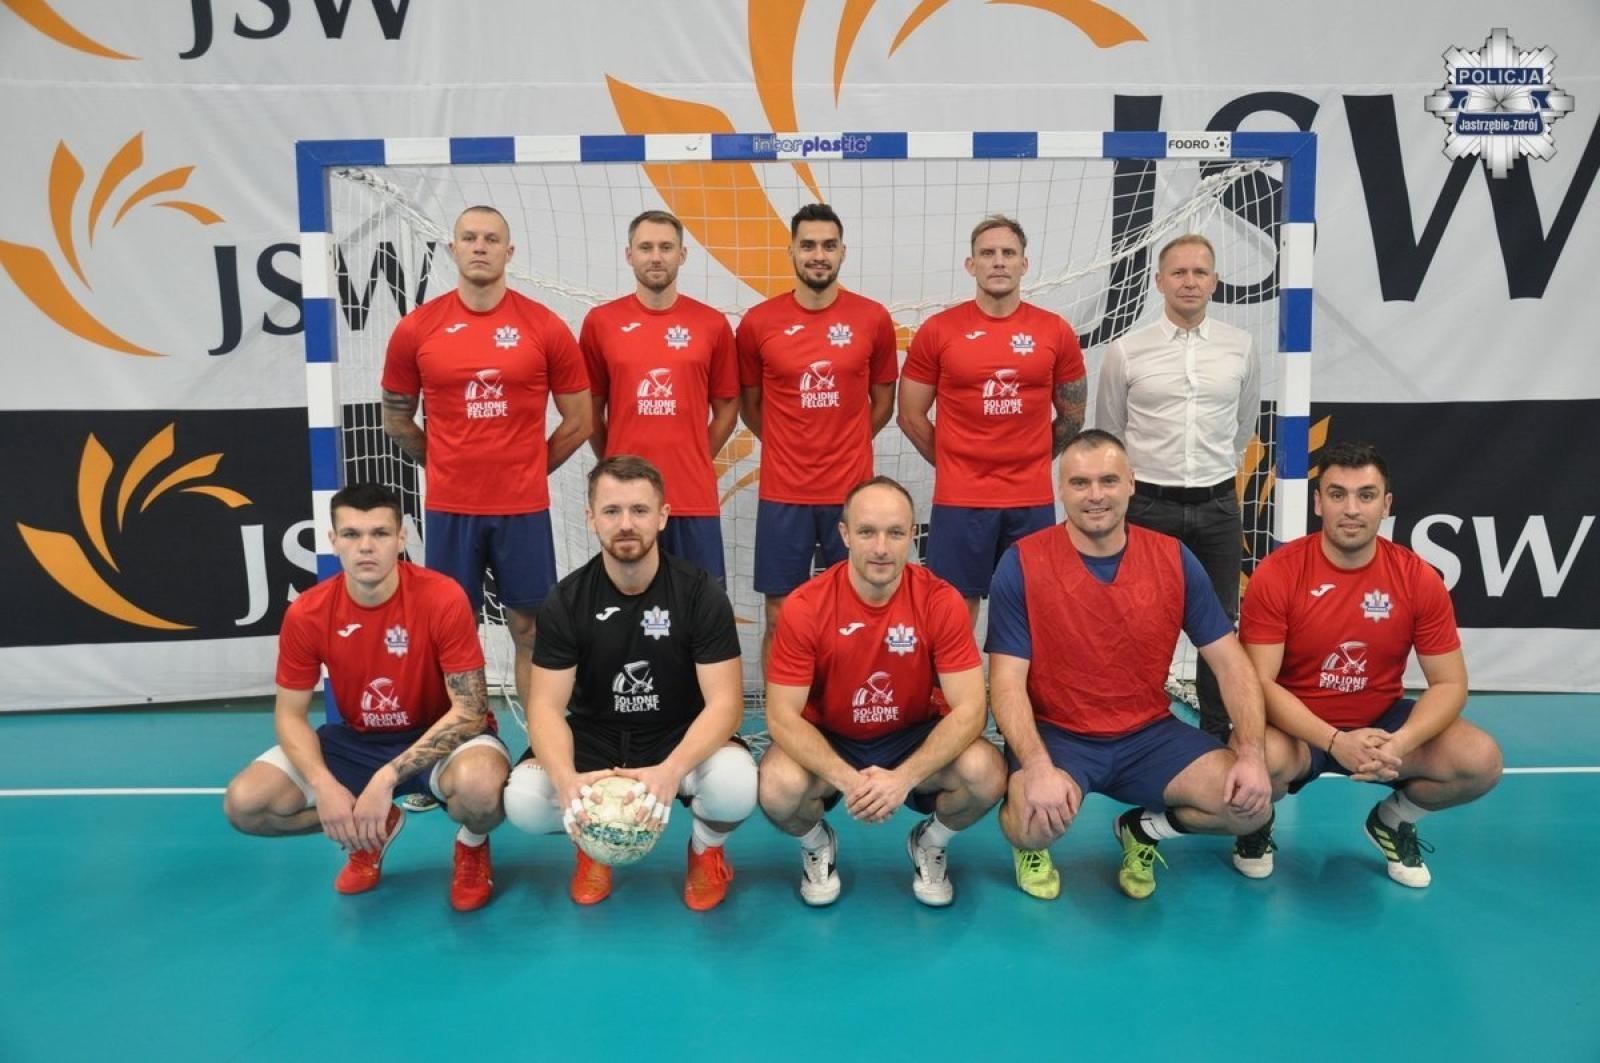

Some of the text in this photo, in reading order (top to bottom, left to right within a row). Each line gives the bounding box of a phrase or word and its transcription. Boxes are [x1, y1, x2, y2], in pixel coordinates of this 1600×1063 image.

[753, 135, 867, 157] interplastic
[1168, 139, 1210, 149] FOORO
[208, 242, 437, 356] JSW
[800, 391, 840, 401] SOLIDNE
[467, 401, 508, 410] SOLIDNE
[637, 399, 677, 408] SOLIDNE
[801, 399, 840, 409] FELGI.PL
[984, 399, 1023, 407] SOLIDNE
[467, 408, 508, 418] FELGI.PL
[638, 407, 677, 416] FELGI.PL
[984, 406, 1023, 415] FELGI.PL
[1320, 672, 1368, 686] SOLIDNE
[614, 694, 660, 704] SOLIDNE
[614, 702, 660, 712] FELGI.PL
[853, 705, 899, 717] SOLIDNE
[853, 713, 900, 723] FELGI.PL
